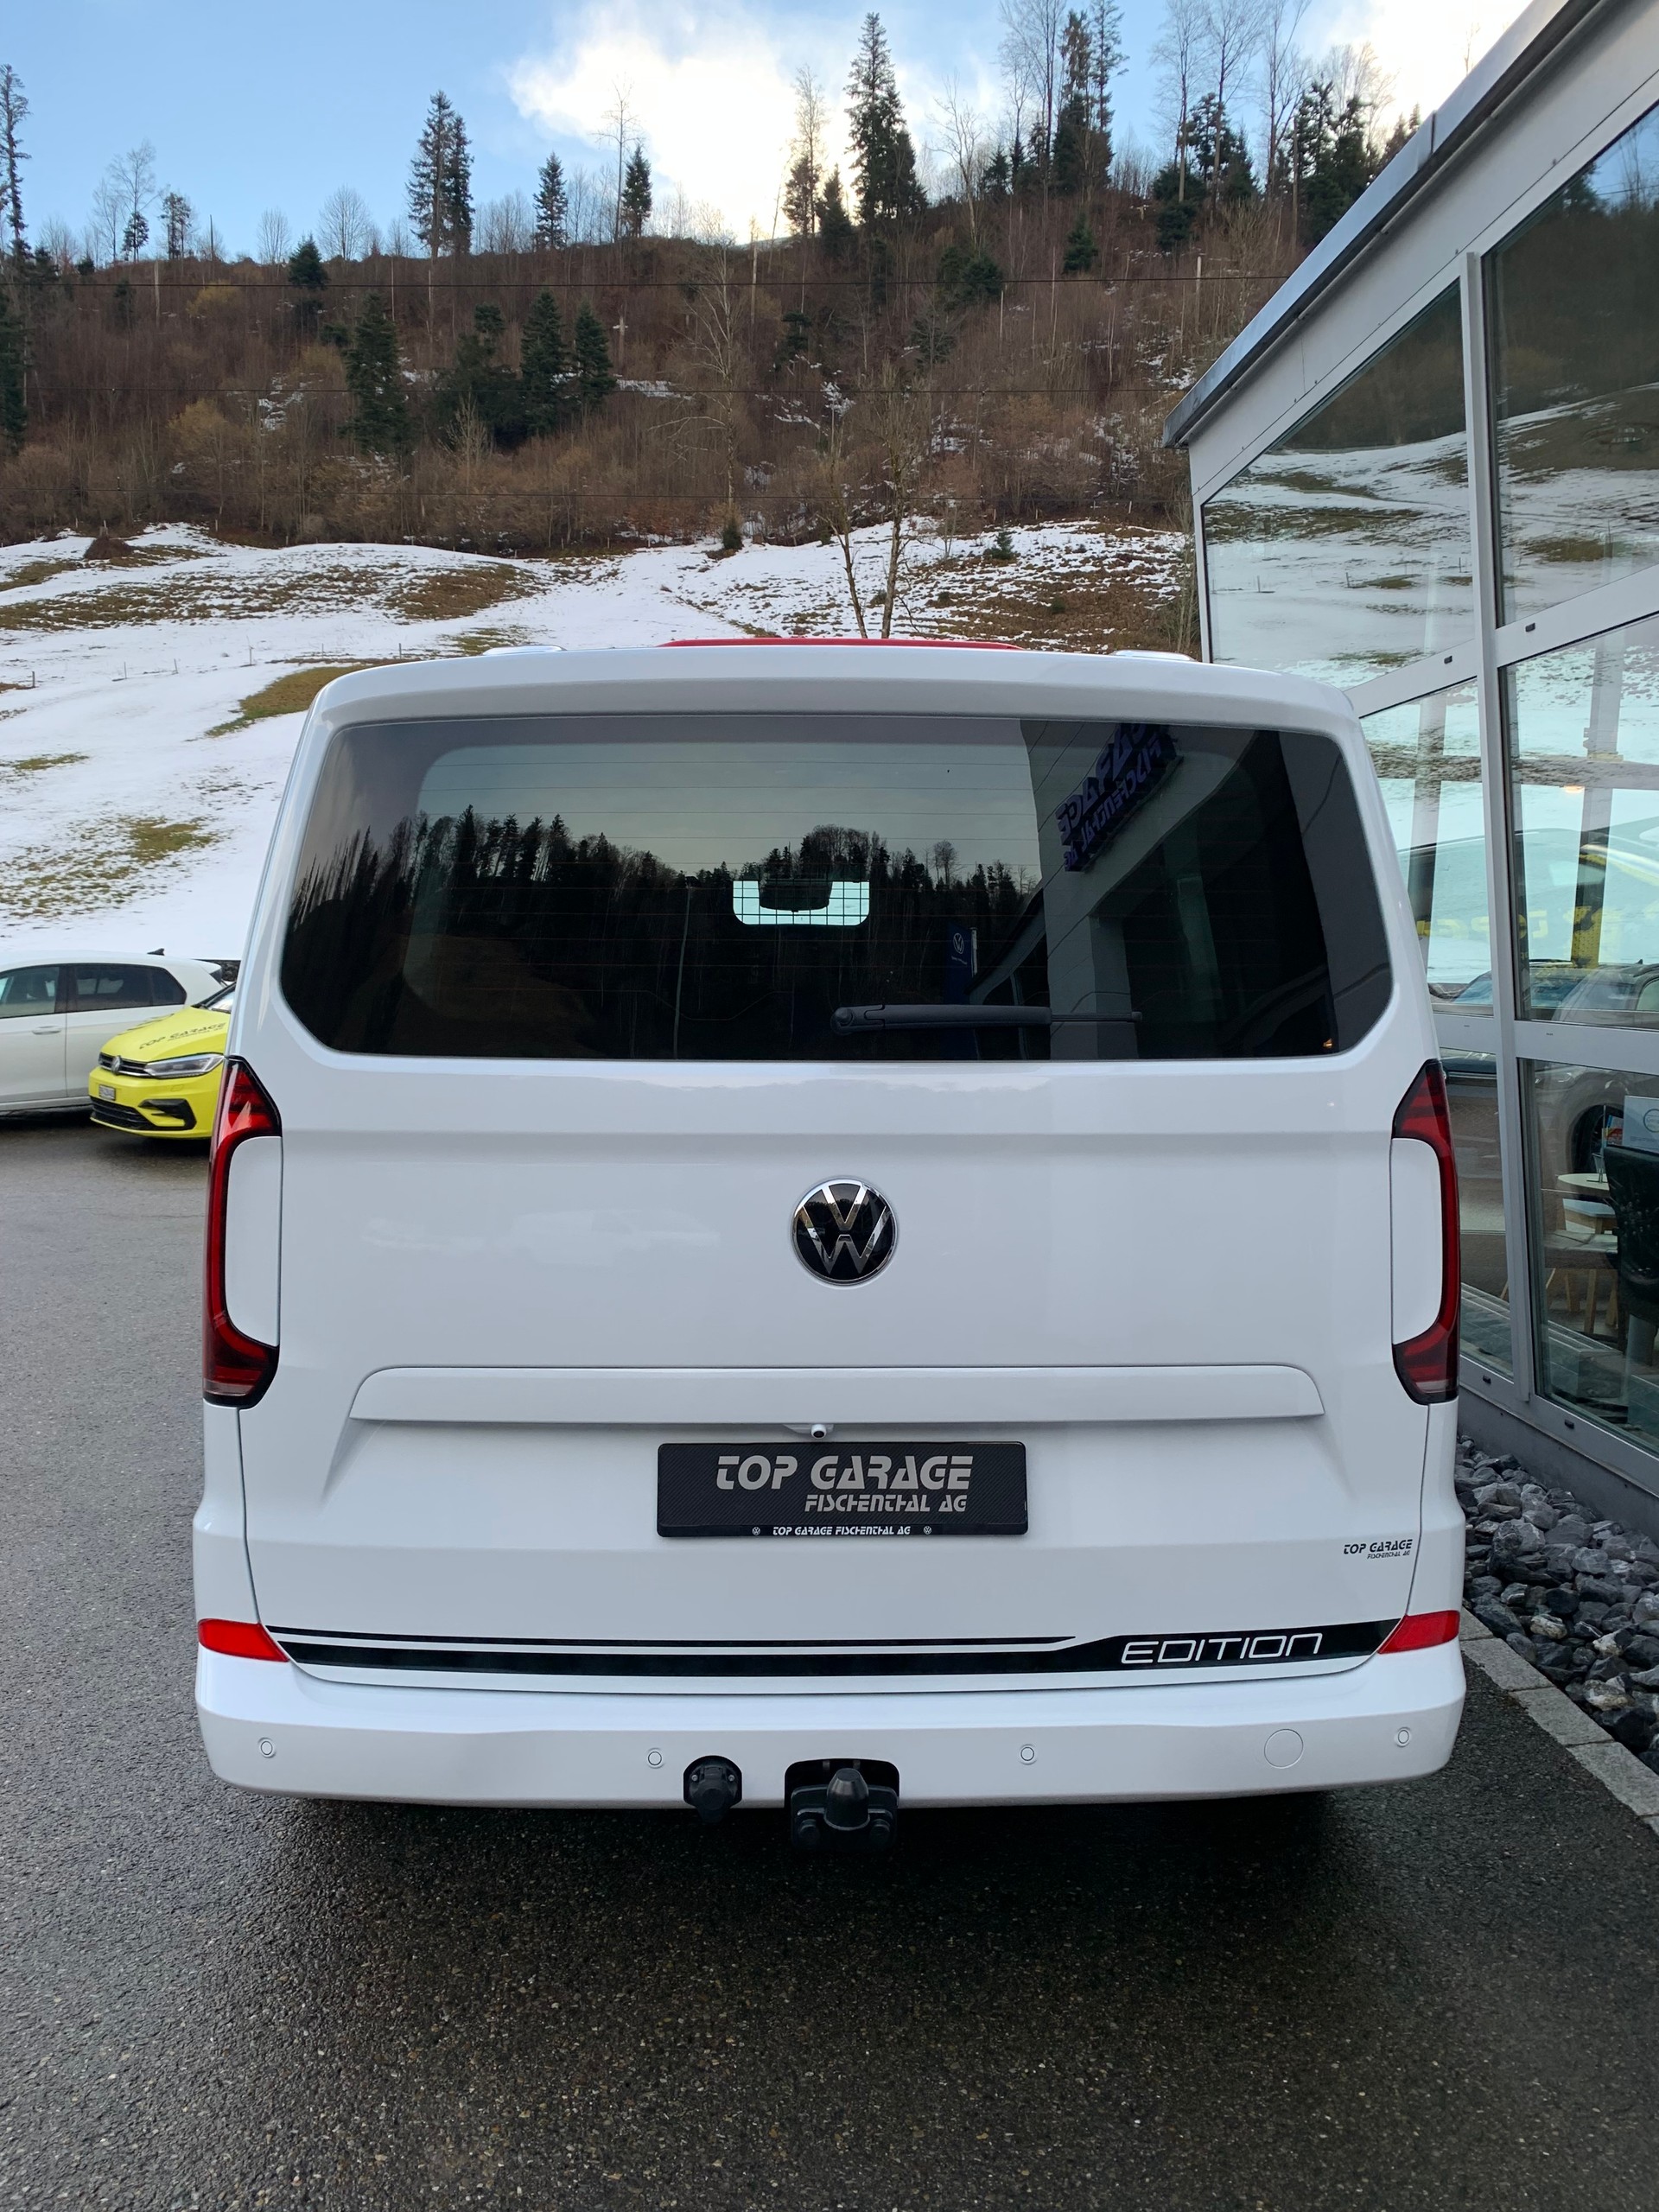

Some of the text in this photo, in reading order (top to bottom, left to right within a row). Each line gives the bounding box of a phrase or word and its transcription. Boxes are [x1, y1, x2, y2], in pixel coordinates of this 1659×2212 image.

[715, 1455, 974, 1490] TOP GARAGE
[804, 1494, 968, 1512] FISCHENTHAL AG
[772, 1526, 792, 1535] TOP
[794, 1526, 833, 1535] GARAGE
[835, 1526, 894, 1535] FISCHENTHAL
[897, 1526, 911, 1535] AG
[1344, 1539, 1413, 1554] TOP GARAGE
[1122, 1633, 1323, 1664] EDITION
